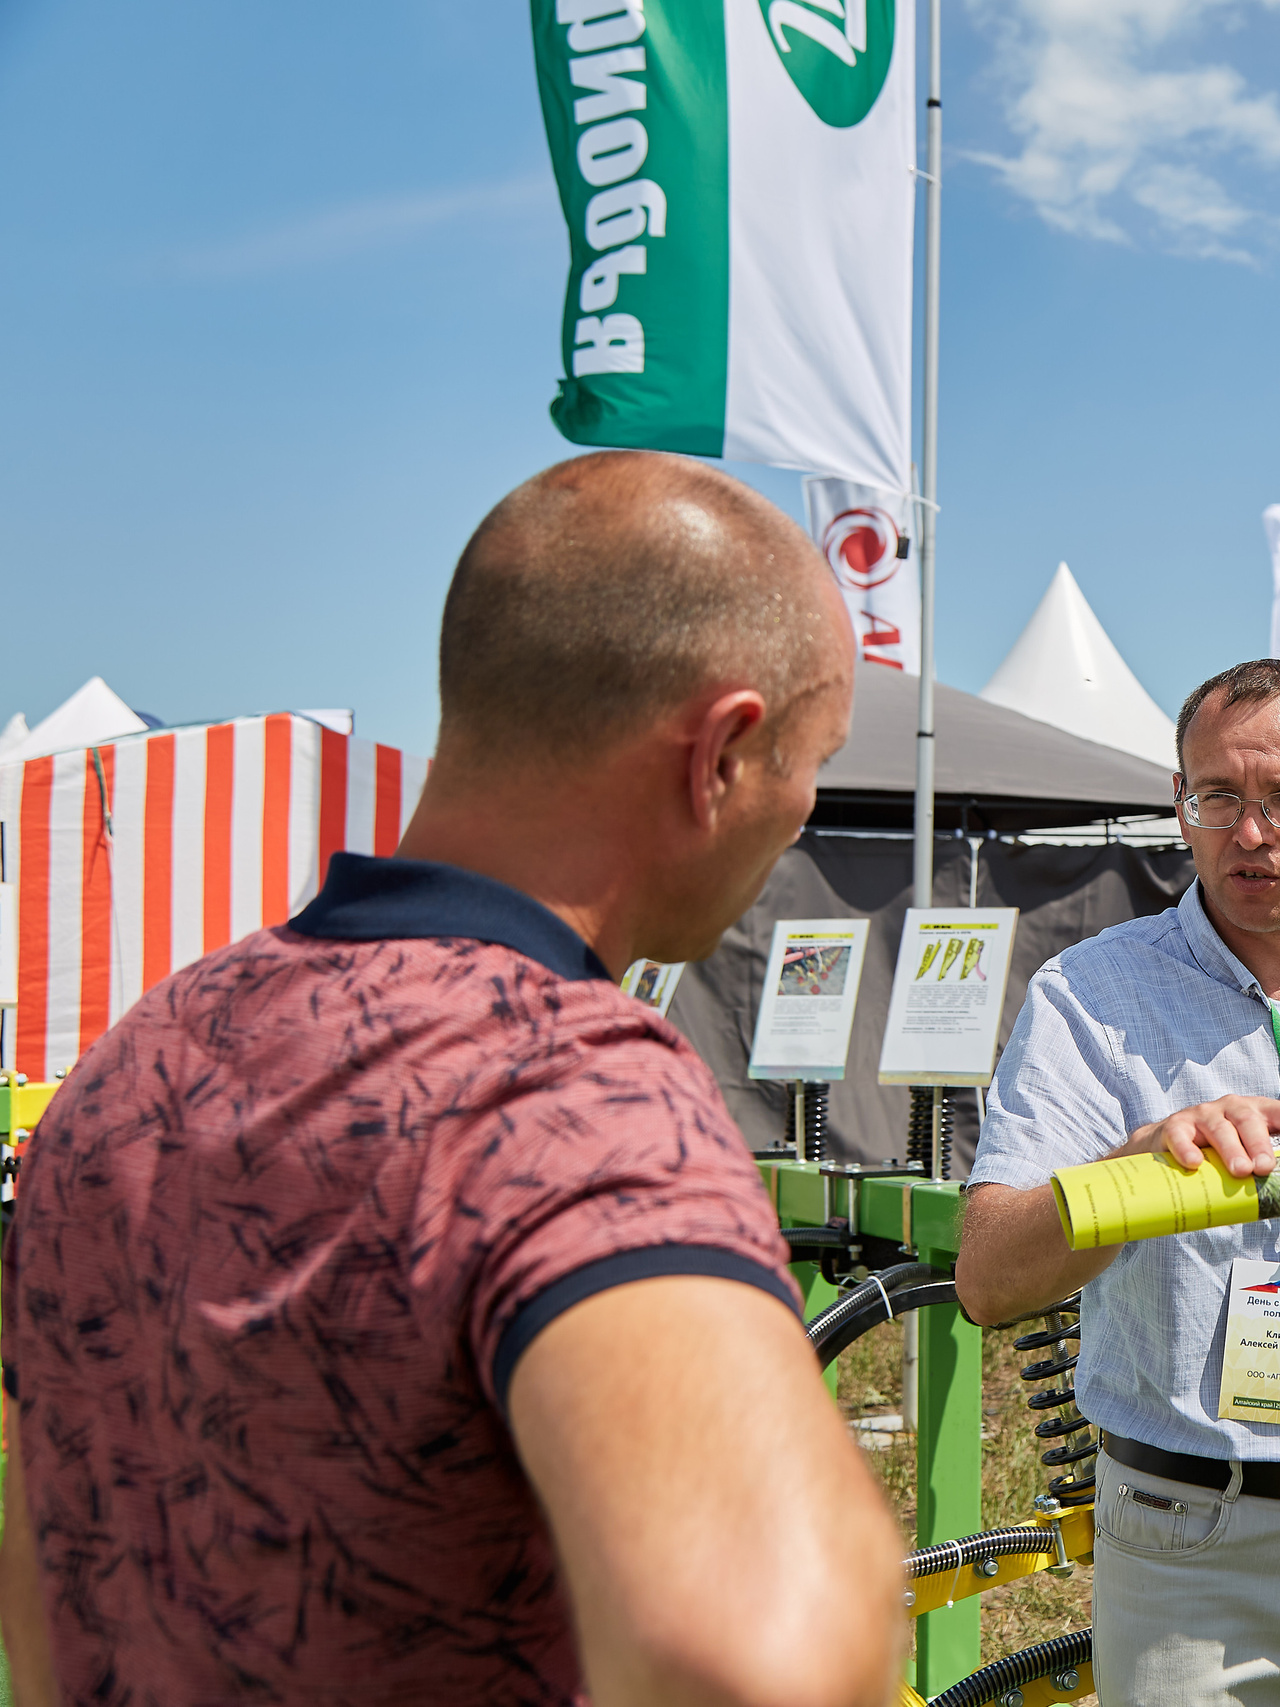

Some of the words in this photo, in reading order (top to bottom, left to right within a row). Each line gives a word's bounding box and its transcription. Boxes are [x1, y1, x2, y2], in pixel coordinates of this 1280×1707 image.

[1247, 1296, 1271, 1307] День
[1240, 1338, 1279, 1350] Алексей
[1247, 1371, 1265, 1379] ООО
[1234, 1399, 1261, 1407] Алтайский
[1261, 1401, 1273, 1409] край
